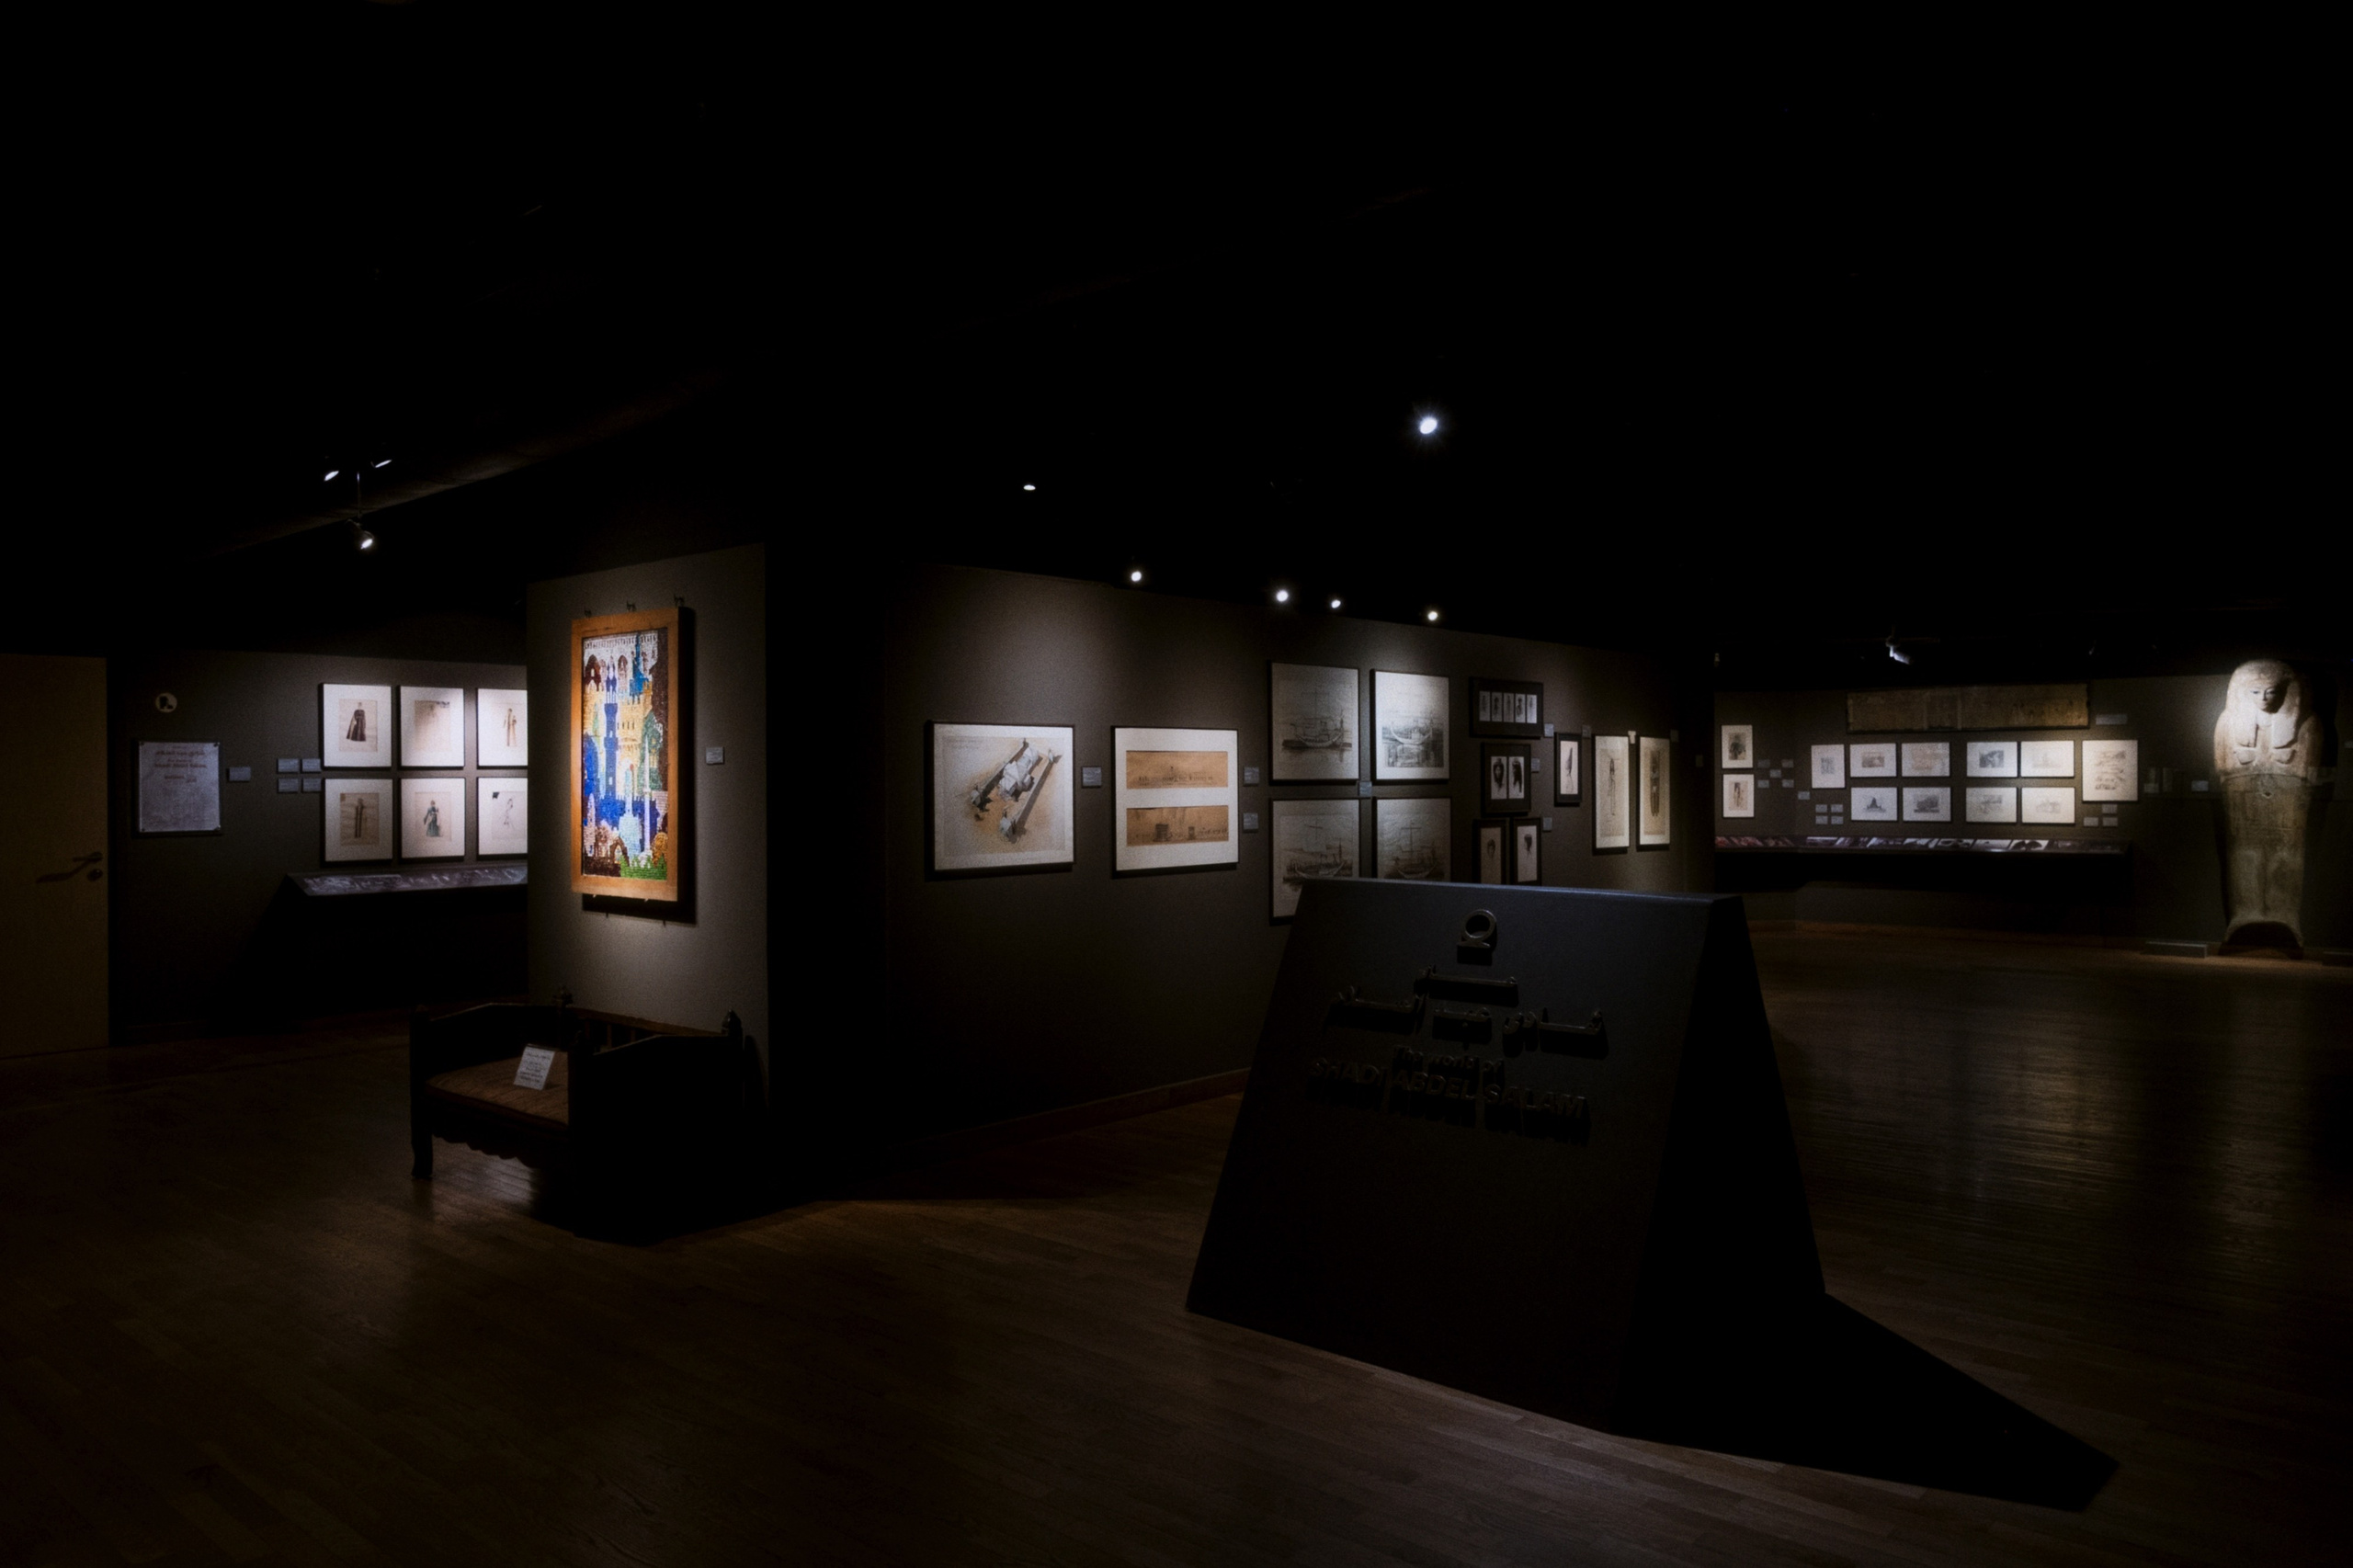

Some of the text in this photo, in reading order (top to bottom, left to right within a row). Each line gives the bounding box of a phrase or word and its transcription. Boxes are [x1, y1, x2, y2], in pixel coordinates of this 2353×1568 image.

[1392, 1045, 1504, 1074] The world of
[1309, 1057, 1586, 1119] SHADI ABDEL SALAM
